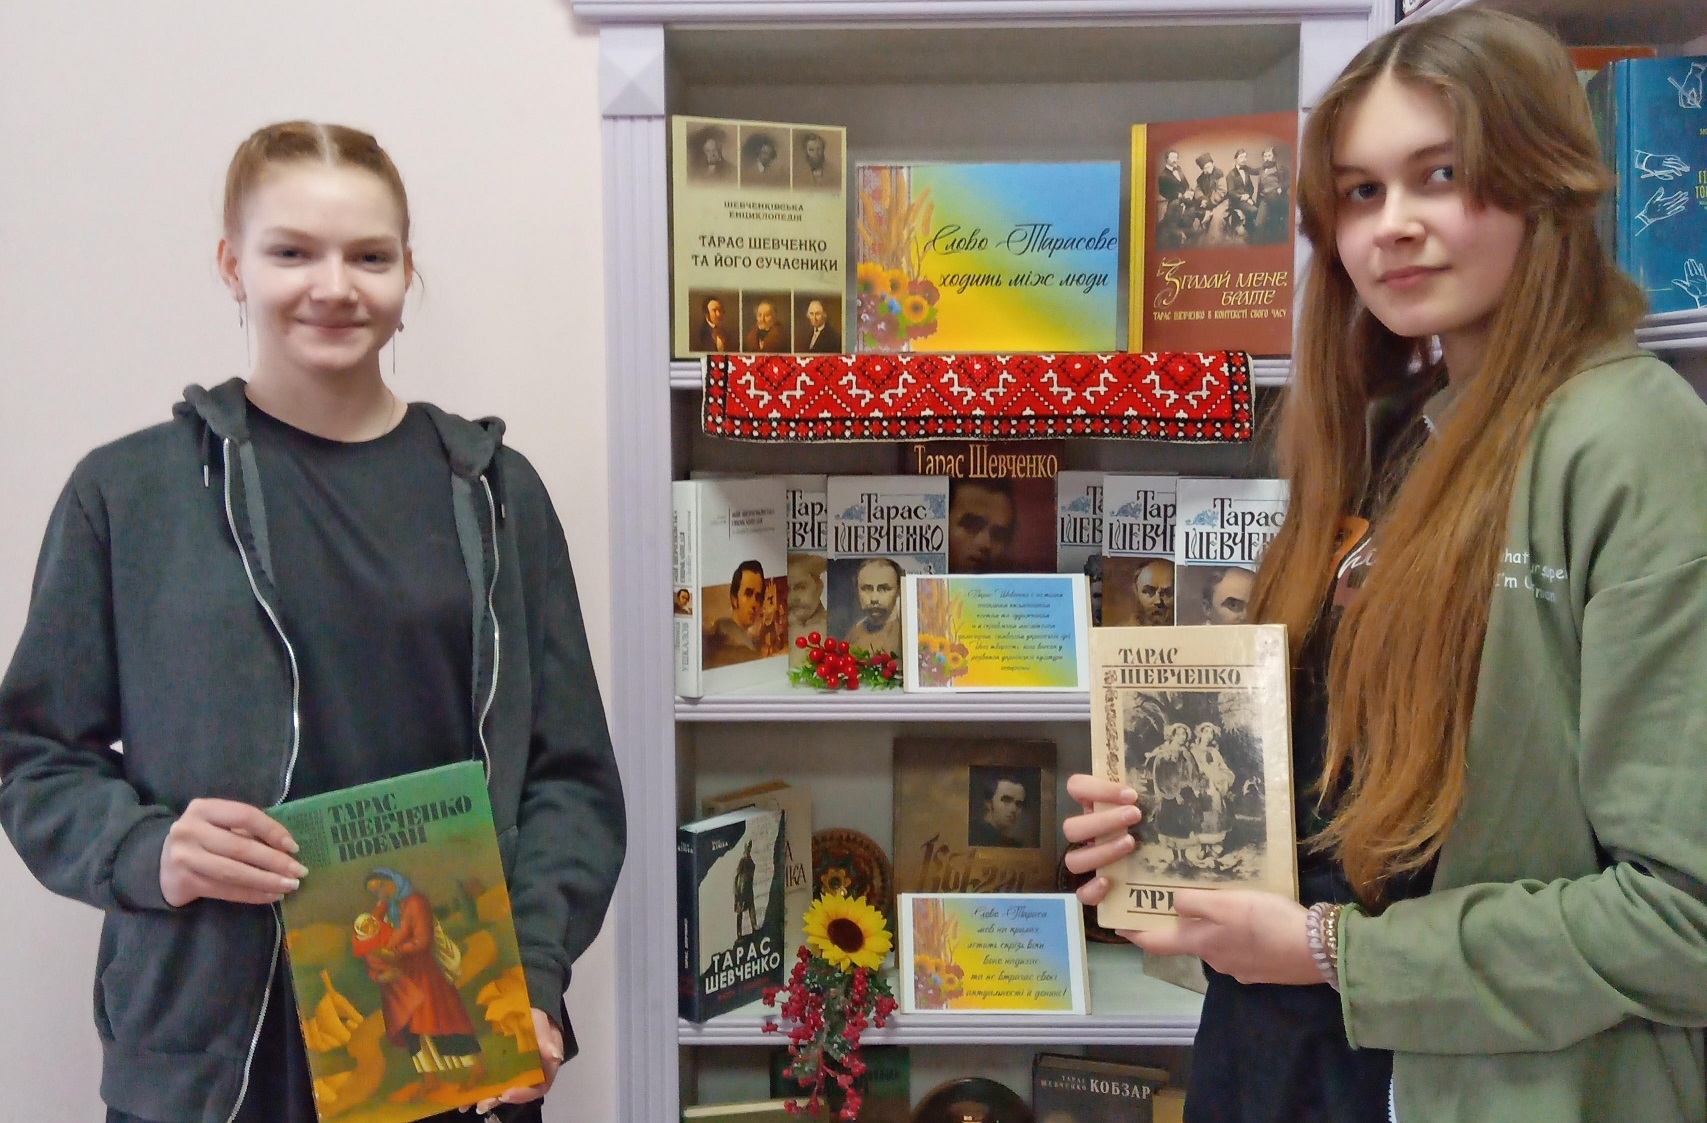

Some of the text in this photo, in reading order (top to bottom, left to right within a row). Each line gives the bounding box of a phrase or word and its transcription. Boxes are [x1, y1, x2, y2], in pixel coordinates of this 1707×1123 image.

[724, 200, 804, 212] ШЕВЧЕНКІВСЬКА
[729, 210, 802, 222] ЕНЦИКЛОПЕДІЯ
[698, 234, 828, 253] ТАРАС ШЕВЧЕНКО
[924, 223, 1118, 258] Слово Тарасове
[691, 252, 838, 273] ТА ЙОГО СУЧАСНИКИ
[939, 270, 1109, 294] ходить між люди
[1153, 311, 1171, 321] ТАРАС
[1214, 309, 1248, 320] КОНТЕКСТІ
[1250, 309, 1269, 319] СВОГО
[1271, 308, 1287, 319] ЧАСУ
[969, 443, 1058, 479] Шевченко
[786, 489, 827, 519] Тар
[861, 492, 927, 523] Тарас
[1136, 490, 1175, 521] Тар
[1213, 497, 1285, 529] Тарас
[834, 522, 944, 553] ШЕВЧЕНКО
[1060, 513, 1103, 544] ШЕВ
[1118, 647, 1178, 664] ТАРАС
[1120, 668, 1241, 685] ШЕВЧЕНКО
[328, 792, 397, 823] ТАРАС
[331, 795, 472, 843] ШЕВЧЕНКО
[712, 936, 771, 973] ТАРАС
[705, 952, 781, 995] ШЕВЧЕНКО
[1090, 1078, 1151, 1100] КОБЗАР
